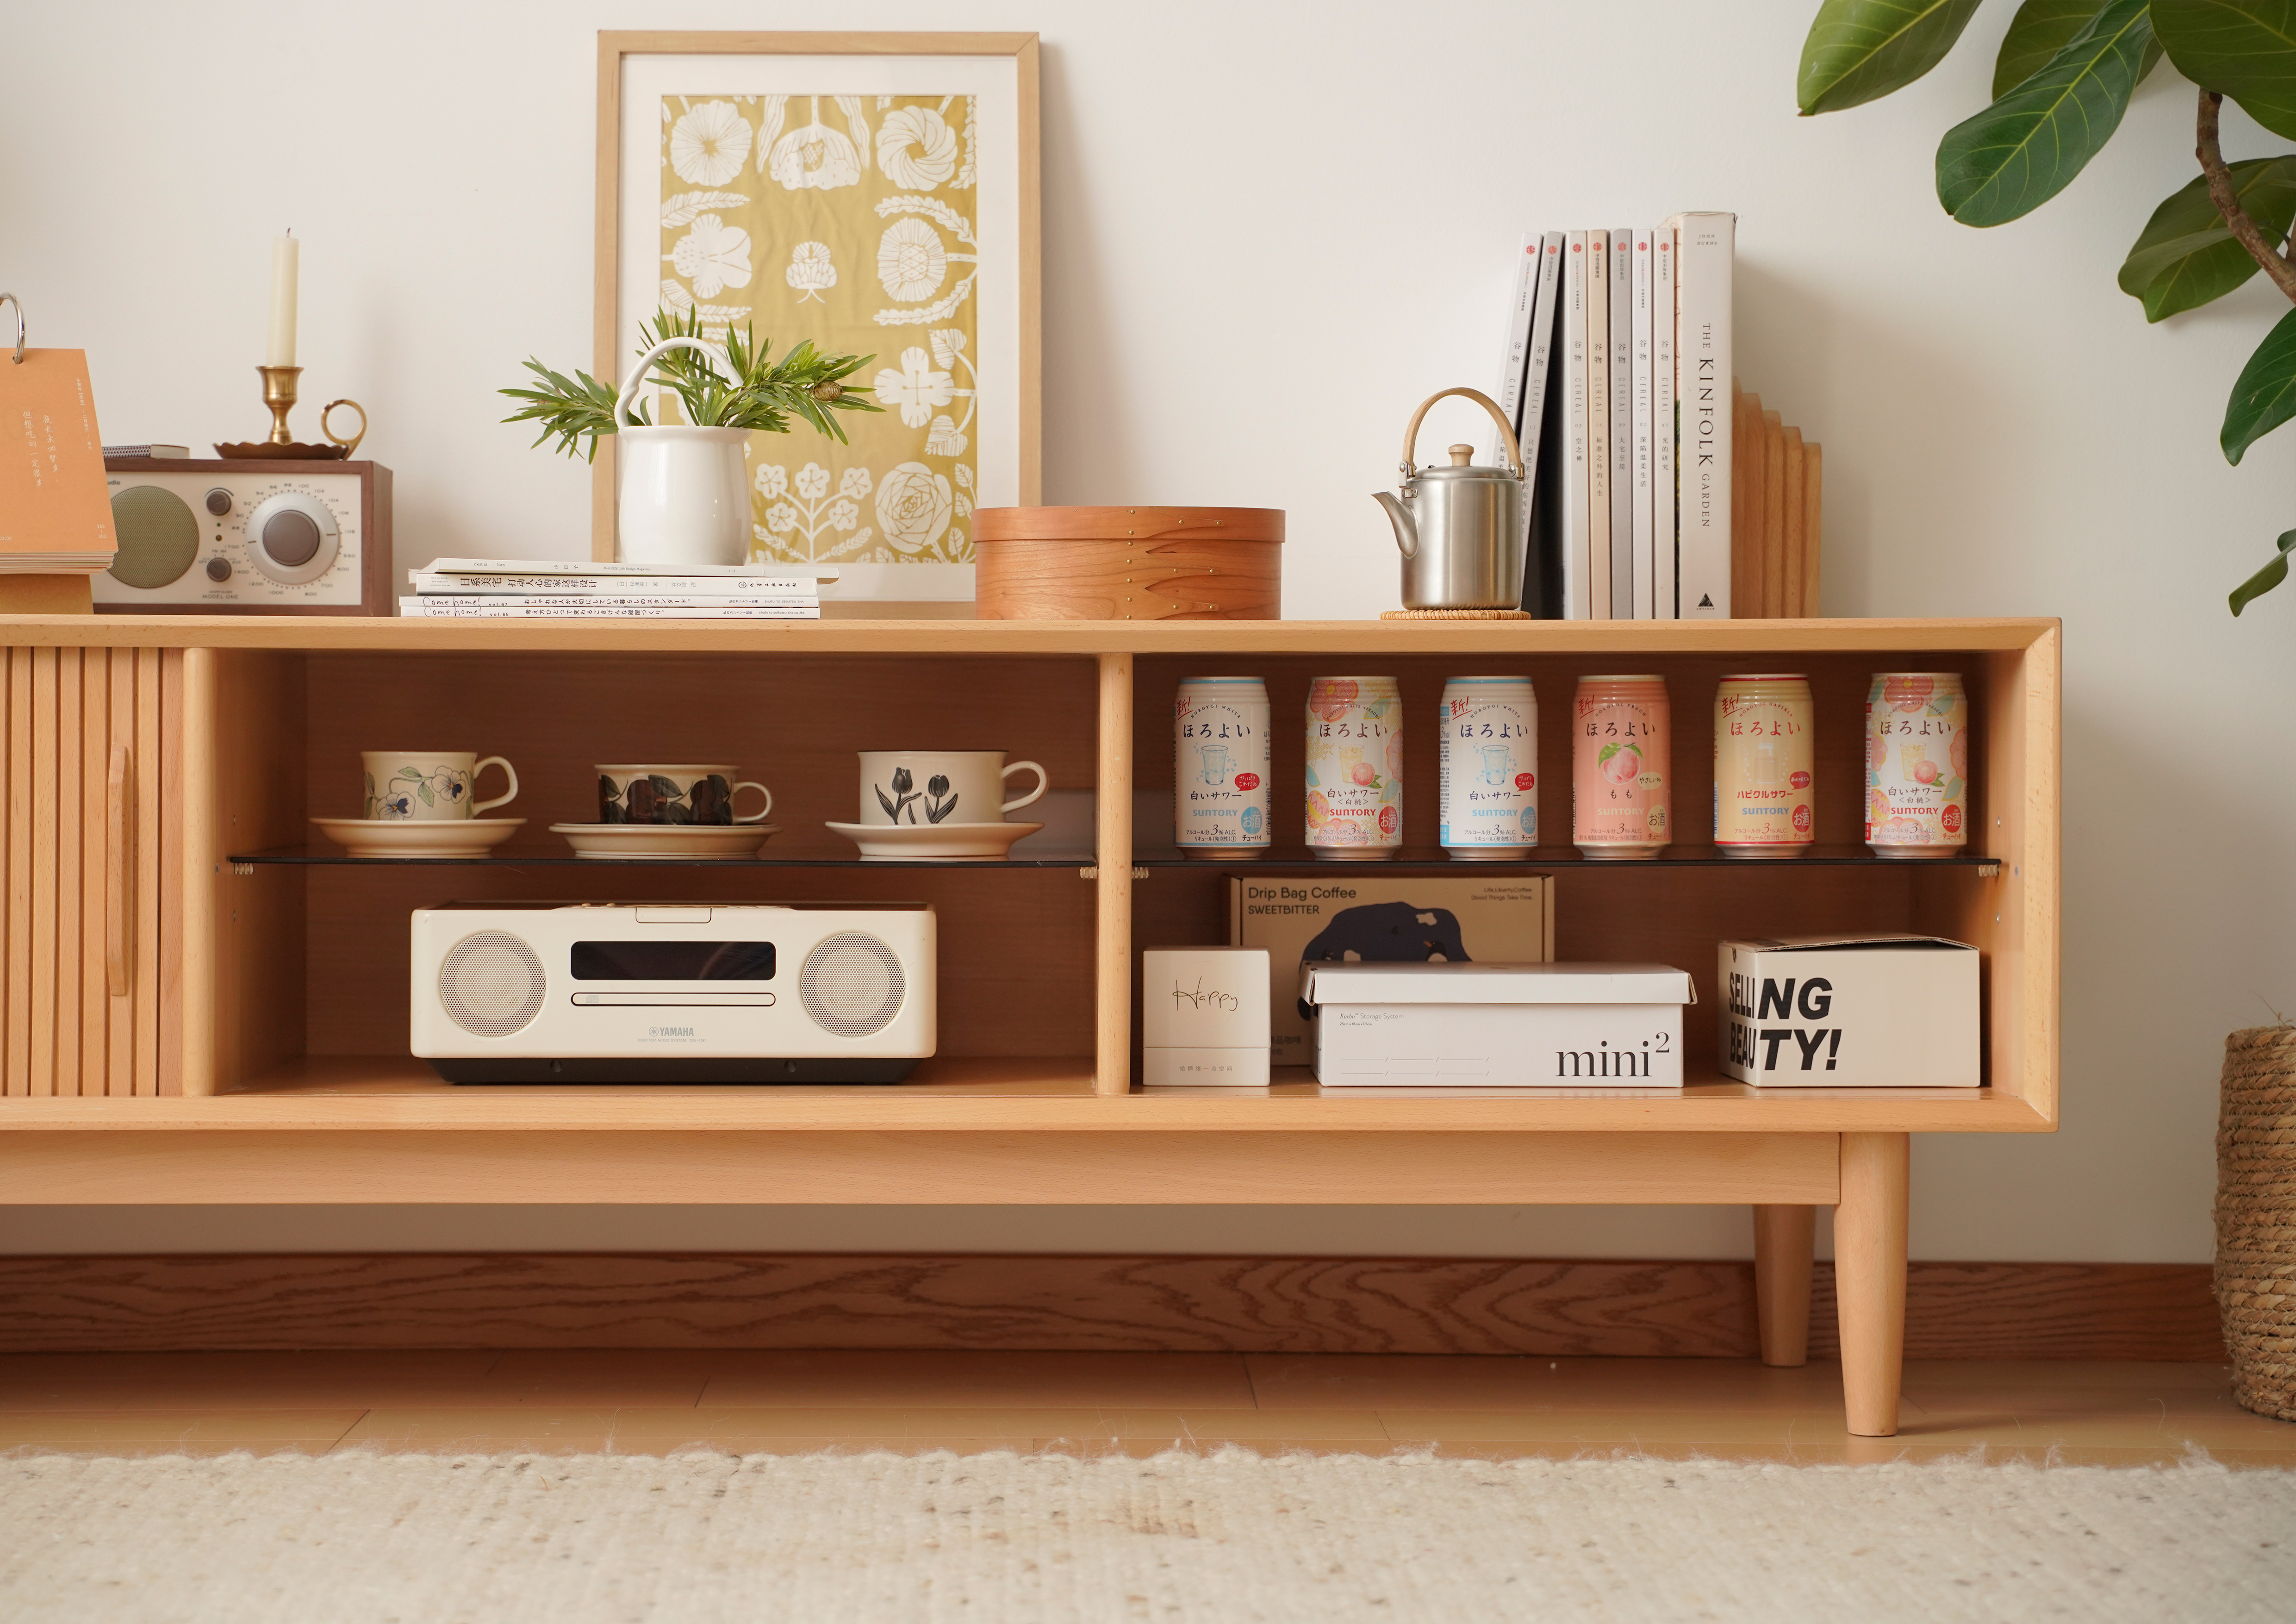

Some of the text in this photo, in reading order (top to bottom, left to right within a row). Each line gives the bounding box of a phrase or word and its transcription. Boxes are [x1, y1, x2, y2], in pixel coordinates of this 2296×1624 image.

[1512, 342, 1521, 363] 谷物
[1536, 346, 1545, 367] 谷物
[1574, 341, 1582, 362] 谷物
[1594, 343, 1602, 364] 谷物
[1618, 343, 1626, 364] 谷物
[1639, 339, 1647, 361] 谷物
[1661, 340, 1668, 362] 谷物
[1505, 378, 1516, 413] CEREAL
[1531, 379, 1541, 414] CEREAL
[1699, 323, 1713, 527] THE KINFOLK GARDEN
[23, 410, 42, 487] 但想吃的一定很多
[460, 577, 597, 588] 日系美宅 打动人心的家这样设计
[423, 596, 449, 606] Come
[453, 597, 480, 606] home!
[424, 606, 450, 617] Come
[454, 607, 481, 617] home!
[1191, 705, 1241, 718] HOROYOI WHITE
[1470, 705, 1521, 718] HOROYOI WHITE
[1595, 703, 1646, 718] HOROYOI PEACH
[1739, 702, 1793, 718] HOROYOI HAPIKLE
[1183, 723, 1250, 738] ほろよい
[1319, 723, 1387, 738] ほろよい
[1461, 723, 1528, 738] ほろよい
[1587, 721, 1655, 737] ほろよい
[1731, 721, 1800, 736] ほろよい
[1880, 720, 1951, 735] ほろよい
[1190, 791, 1242, 800] 白いサワー
[1327, 788, 1379, 798] 白いサワー
[1469, 791, 1521, 800] 白いサワー
[1610, 789, 1632, 799] もも
[1737, 790, 1793, 799] ハピクルサワー
[1888, 787, 1942, 796] 白いサワー
[1243, 814, 1261, 828] お酒
[1380, 814, 1397, 828] お酒
[1522, 815, 1535, 828] お酒
[1649, 813, 1665, 826] お酒
[1794, 812, 1809, 826] お酒
[1943, 812, 1960, 827] お酒
[1248, 887, 1356, 901] Drip Bag Coffee
[1248, 905, 1320, 914] SWEETBITTER
[1172, 976, 1238, 1012] Happy
[1729, 971, 1833, 1020] SELLING
[660, 1027, 694, 1037] YAMAHA
[1730, 1021, 1842, 1070] BEAUTY!
